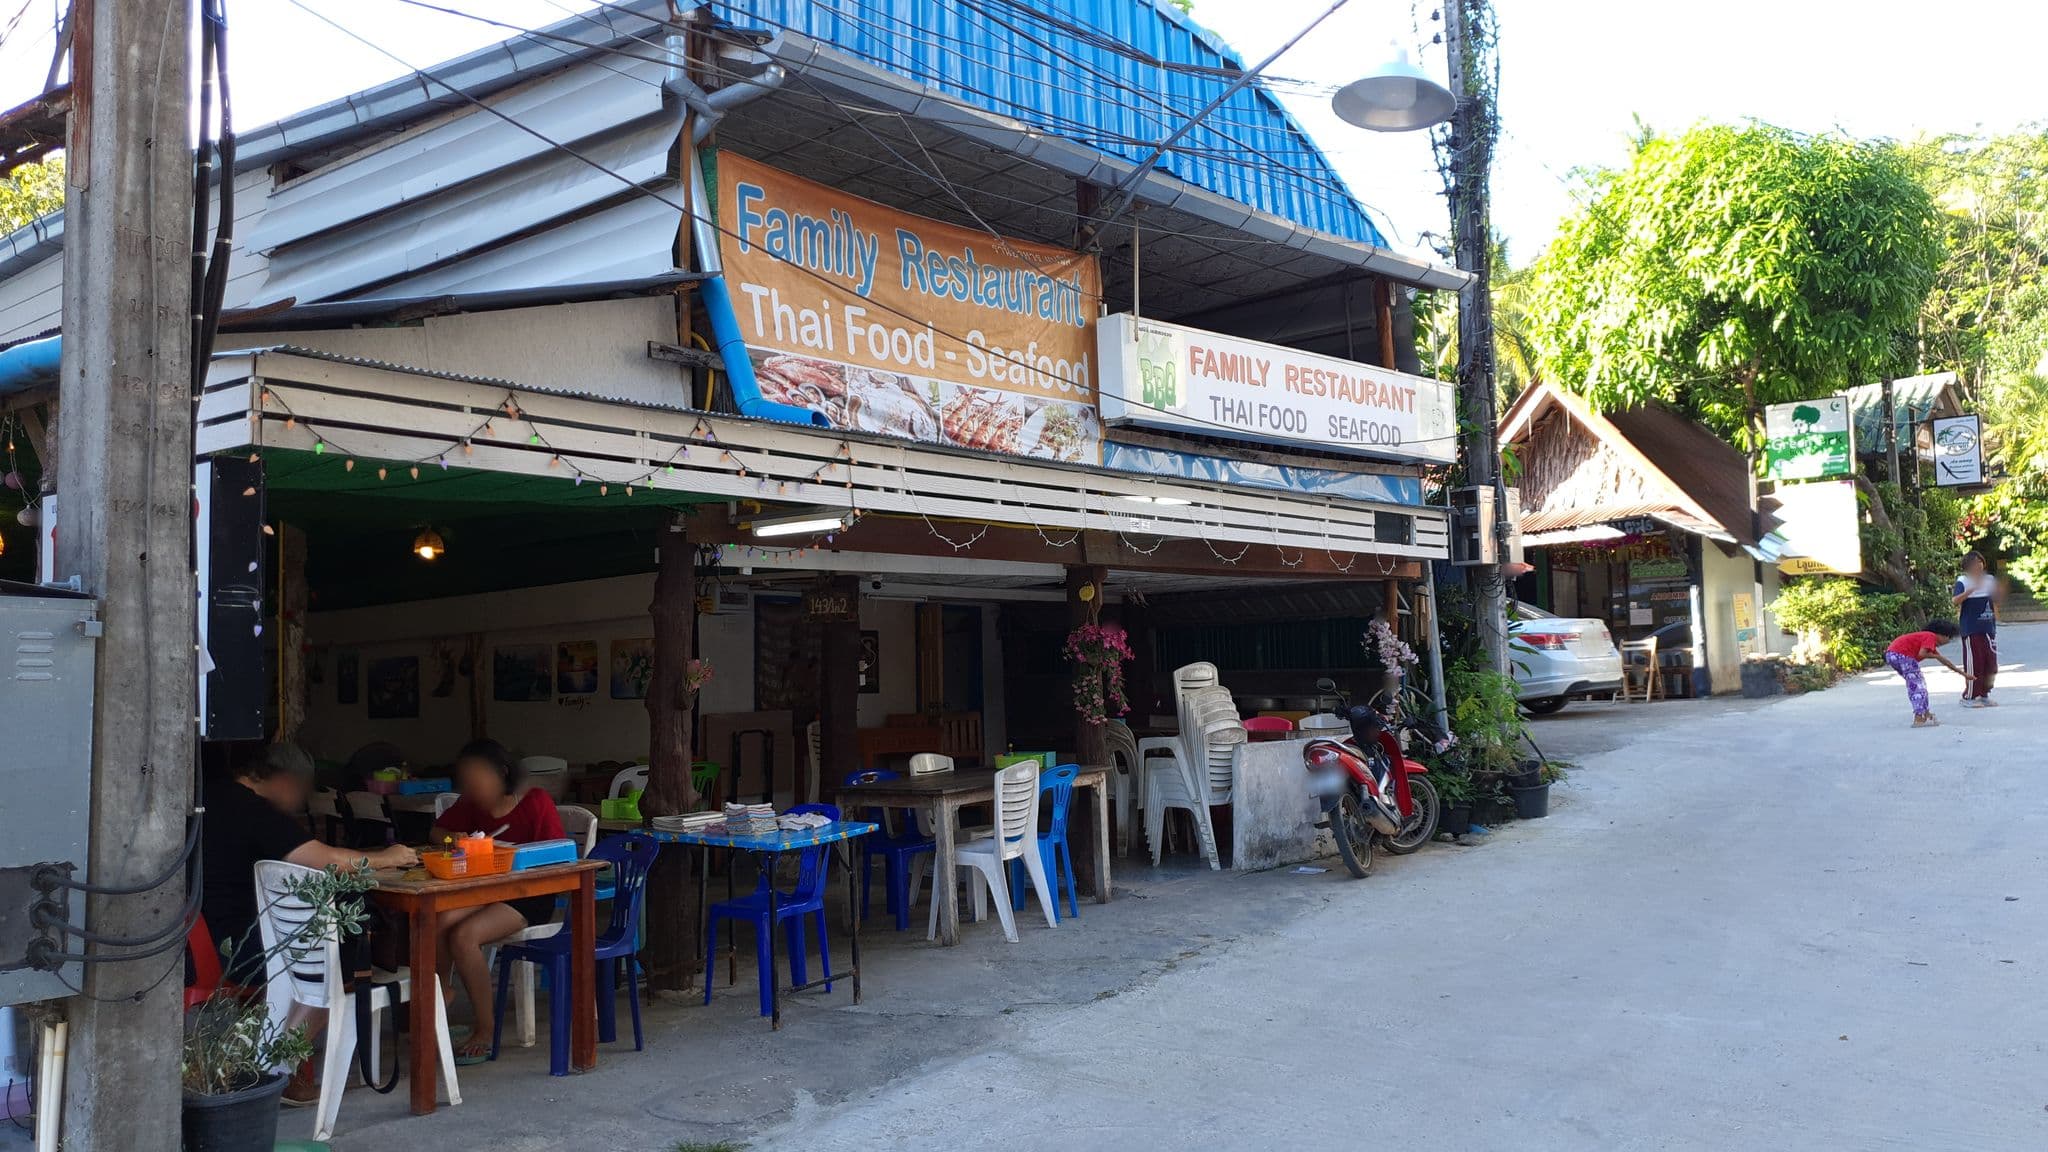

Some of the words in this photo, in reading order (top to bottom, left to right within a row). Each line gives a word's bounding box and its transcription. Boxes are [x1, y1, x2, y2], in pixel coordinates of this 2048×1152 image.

[736, 181, 878, 298] Family
[895, 227, 1086, 328] Restaurant
[740, 282, 834, 351] Thai
[845, 305, 935, 370] Food
[965, 330, 1090, 396] Seafood
[1189, 345, 1271, 387] FAMILY
[1285, 364, 1416, 413] RESTAURANT
[1209, 395, 1252, 425] THAI
[1259, 404, 1307, 434] FOOD
[1328, 414, 1401, 447] SEAFOOD
